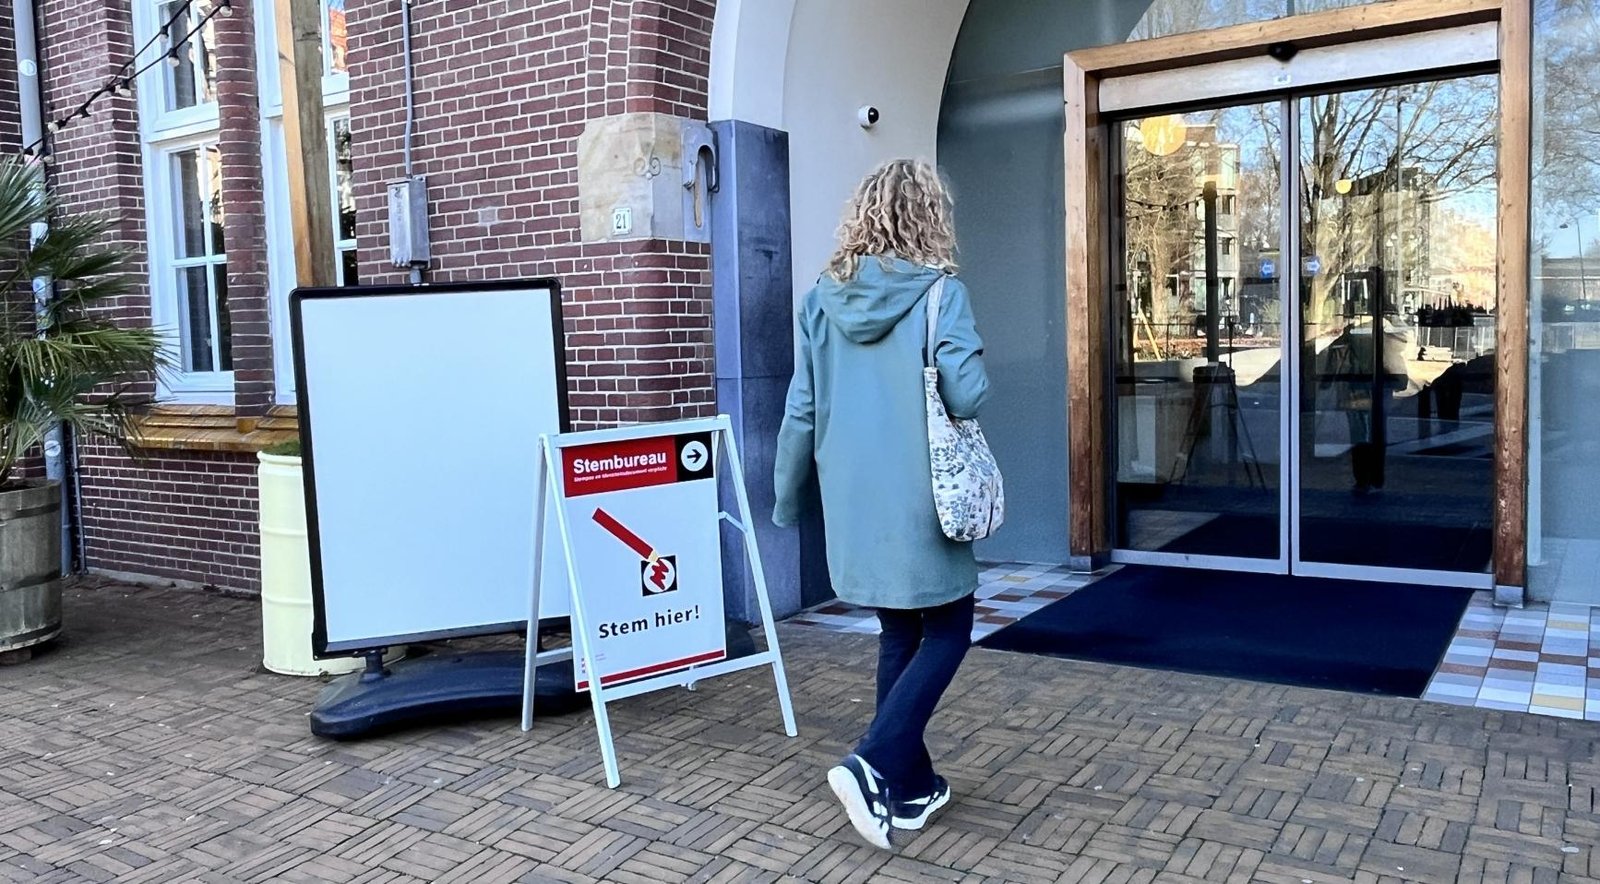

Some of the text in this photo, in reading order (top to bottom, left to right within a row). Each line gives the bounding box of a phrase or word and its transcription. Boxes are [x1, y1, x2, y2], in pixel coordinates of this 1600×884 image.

[615, 213, 626, 229] 21
[573, 452, 667, 474] Stembureau
[599, 604, 699, 639] Stem hier!
